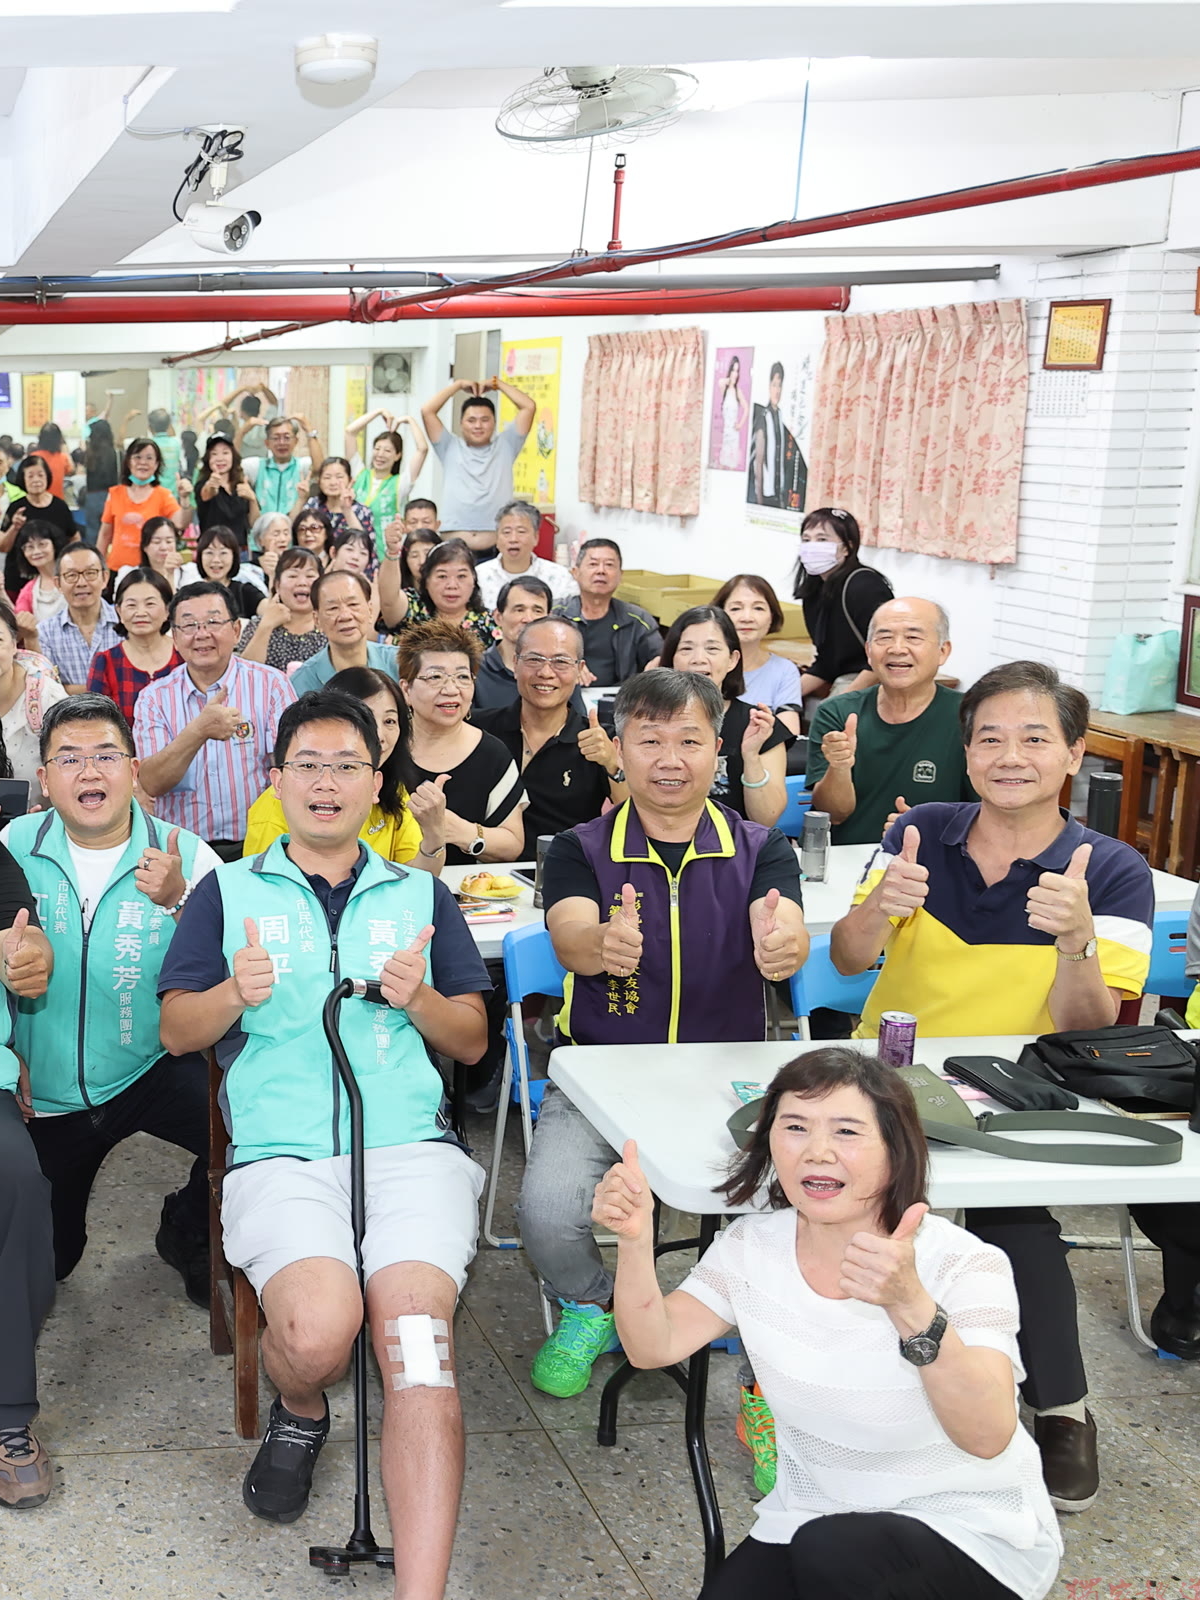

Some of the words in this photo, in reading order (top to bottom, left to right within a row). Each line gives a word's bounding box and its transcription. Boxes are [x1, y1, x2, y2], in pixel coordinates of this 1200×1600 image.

[53, 878, 70, 935] 市民代表
[148, 905, 166, 945] 法委員
[296, 898, 316, 953] 市民代表
[112, 901, 145, 991] 黃秀芳
[119, 991, 133, 1046] 服務團隊
